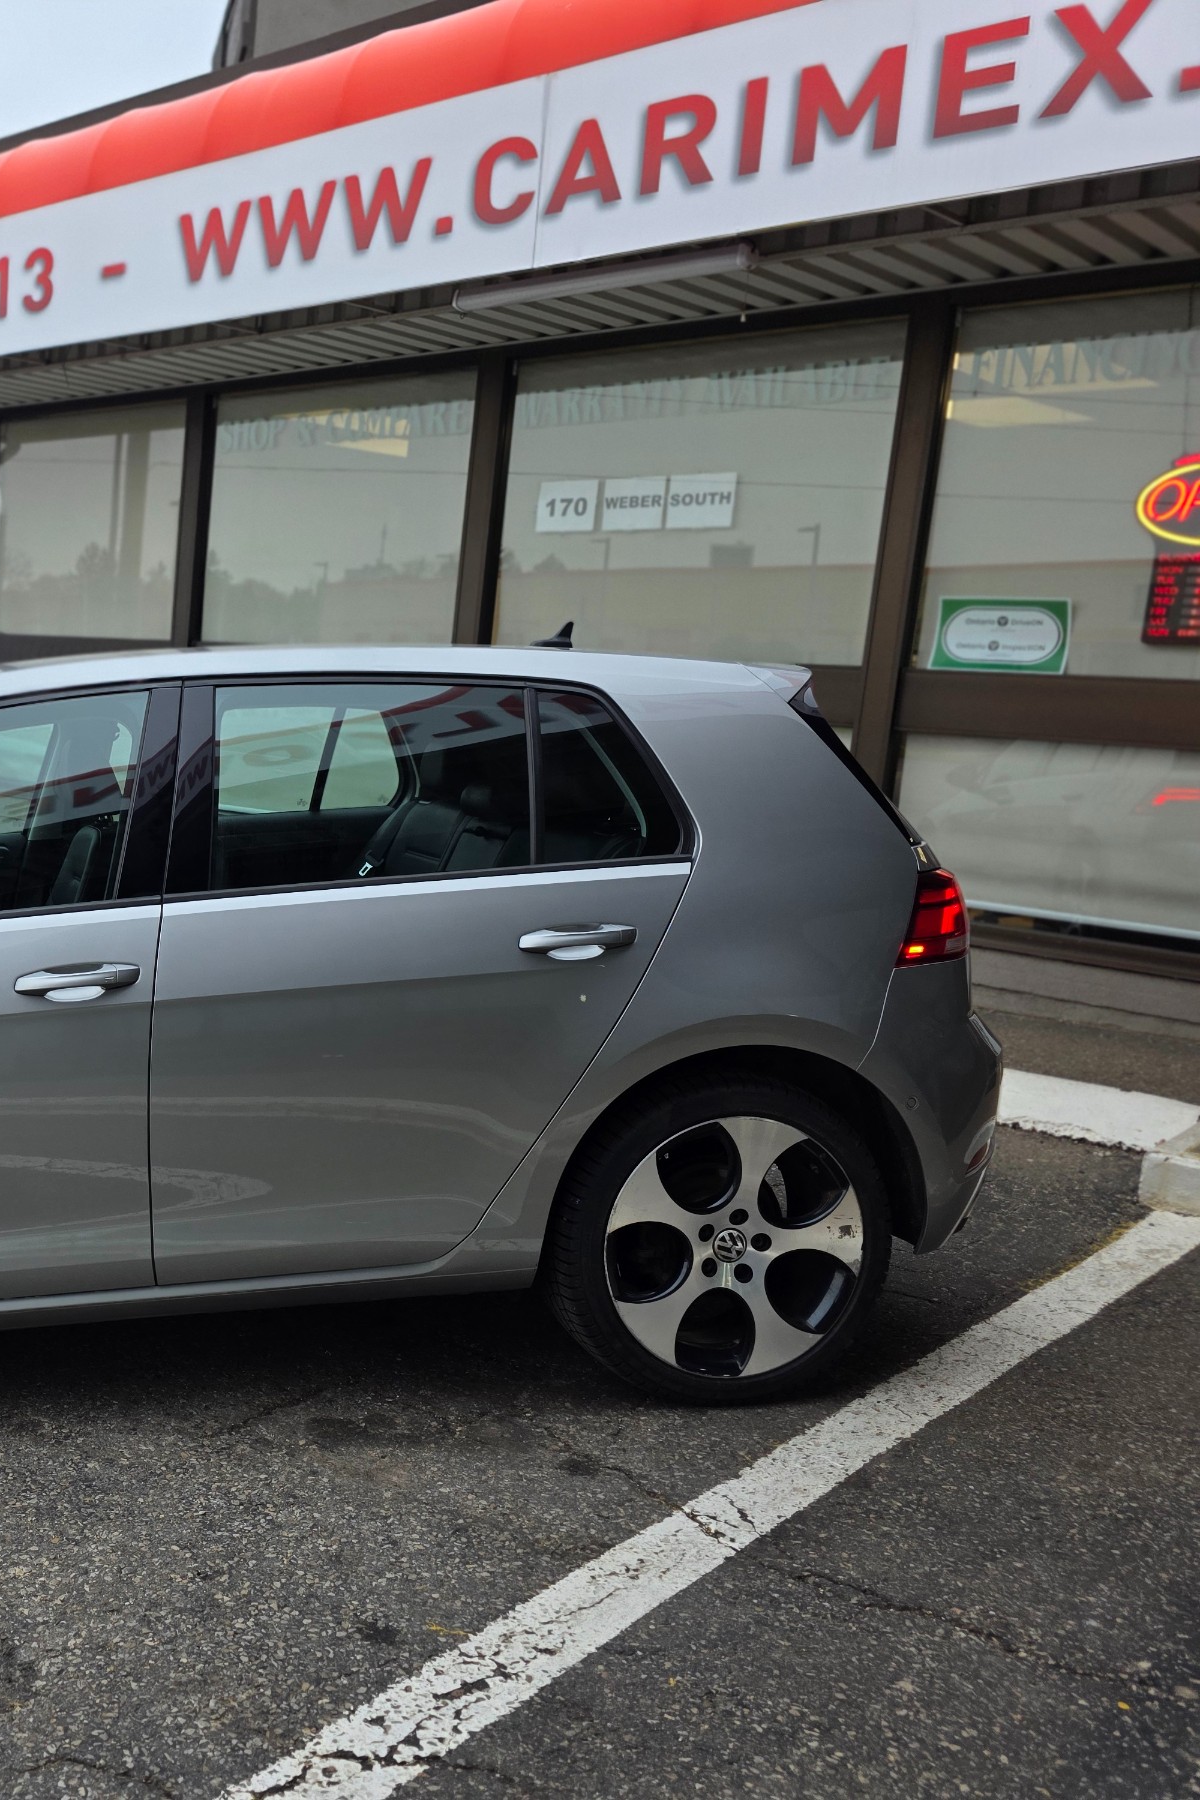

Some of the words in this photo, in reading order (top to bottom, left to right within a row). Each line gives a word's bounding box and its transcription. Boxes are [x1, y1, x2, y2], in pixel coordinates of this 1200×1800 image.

[102, 261, 128, 280] -
[219, 416, 287, 452] SHOP
[326, 398, 471, 442] COMPARE
[545, 497, 588, 517] 170
[605, 494, 662, 509] WEBER
[669, 491, 732, 507] SOUTH
